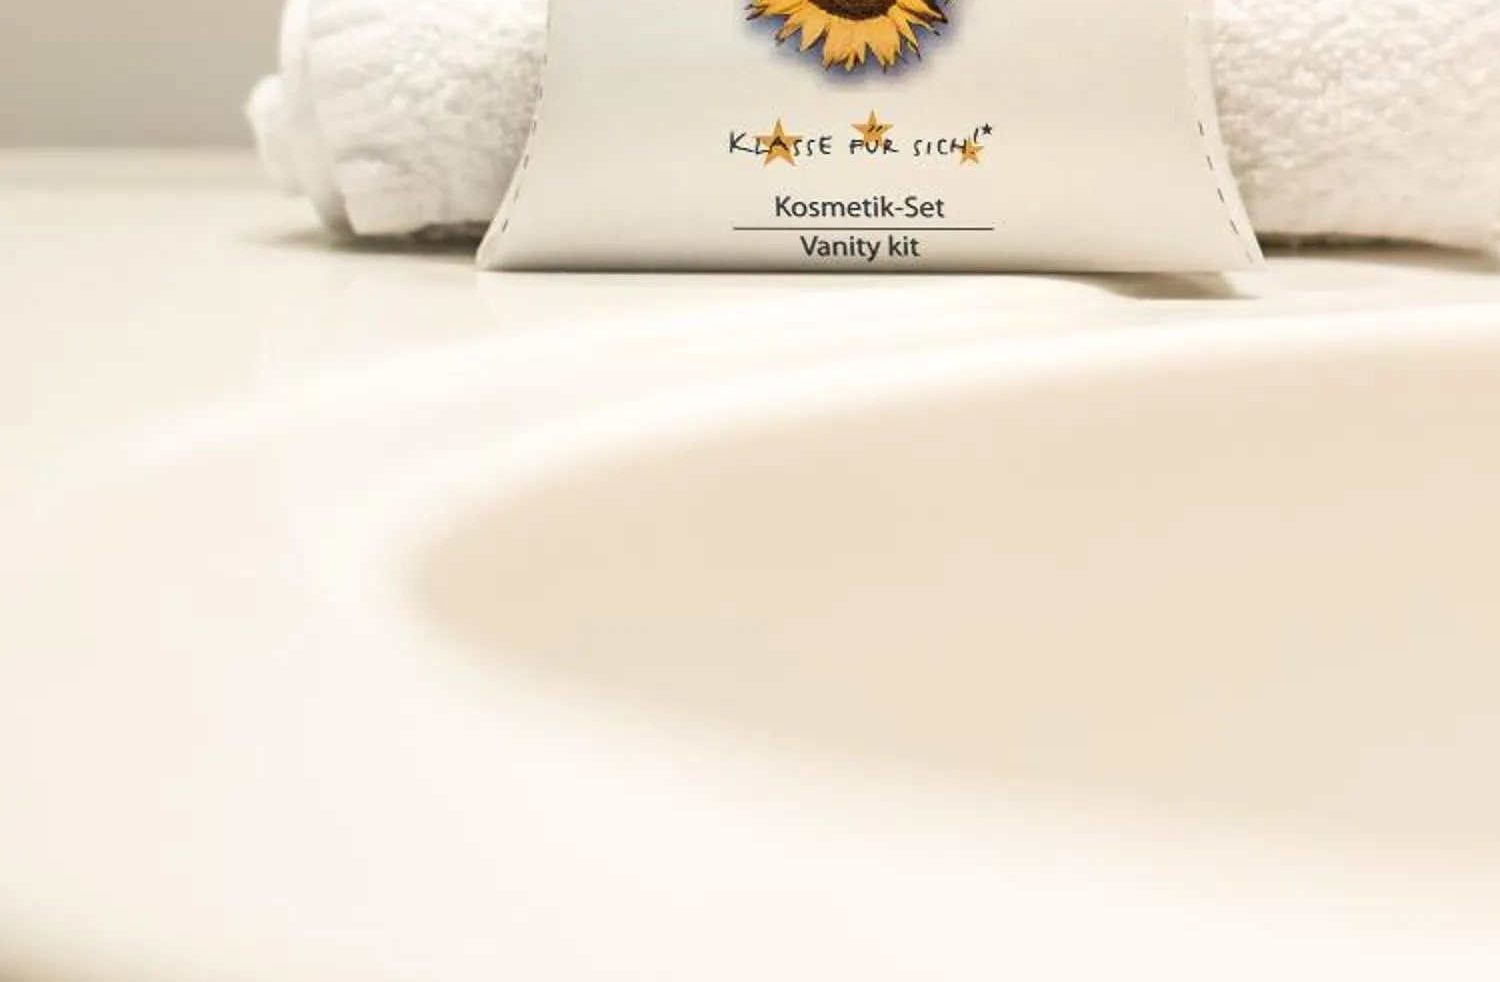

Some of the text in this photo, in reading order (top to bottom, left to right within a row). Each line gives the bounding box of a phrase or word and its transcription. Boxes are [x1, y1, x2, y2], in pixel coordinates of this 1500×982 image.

[729, 131, 833, 156] KLASSE
[849, 125, 899, 155] FÜR
[774, 195, 945, 219] Kosmetik-Set
[800, 234, 920, 261] Vanity kit
